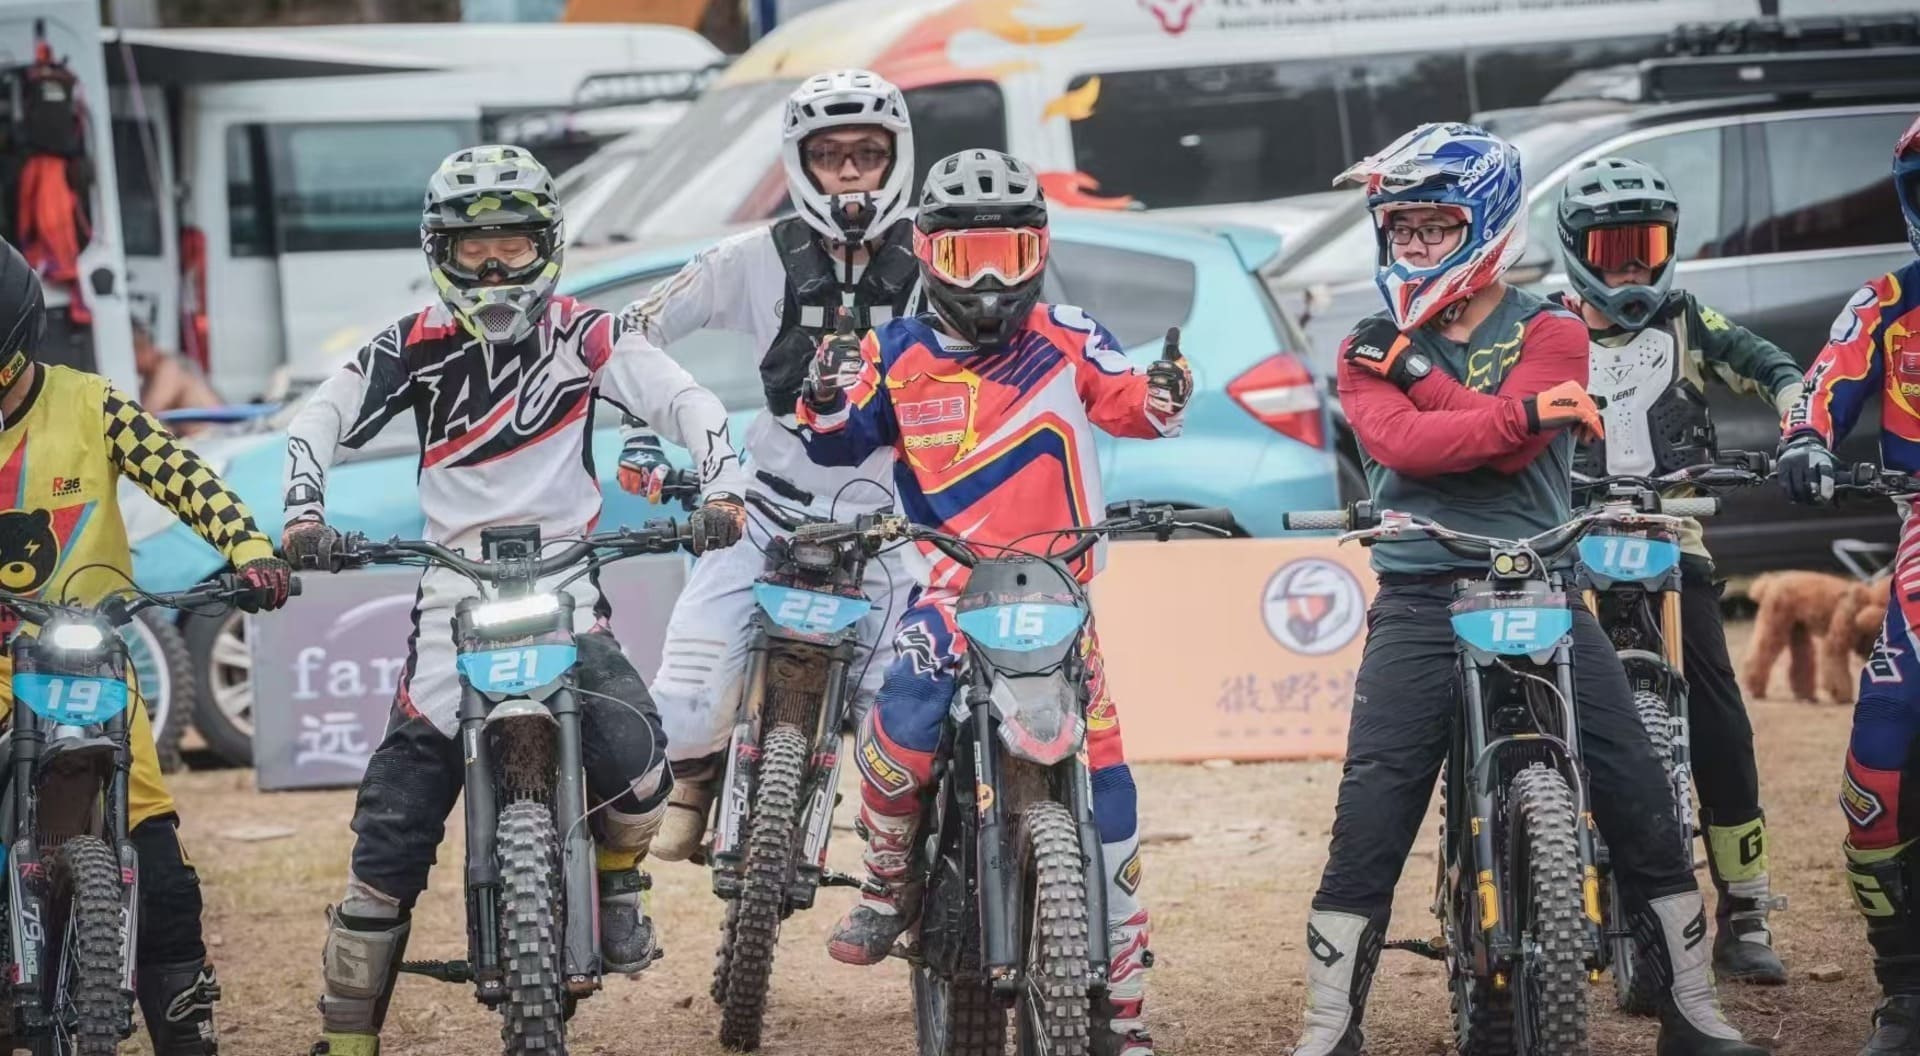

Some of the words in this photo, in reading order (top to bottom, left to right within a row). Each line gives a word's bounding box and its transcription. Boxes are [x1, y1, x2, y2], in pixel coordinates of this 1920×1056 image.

[900, 396, 966, 426] BSE
[53, 477, 80, 492] R36
[1603, 540, 1650, 569] 10
[778, 591, 841, 625] 22
[997, 603, 1046, 638] 16
[1490, 610, 1537, 642] 12
[489, 649, 539, 684] 21
[47, 679, 101, 713] 19
[863, 742, 907, 787] BSE
